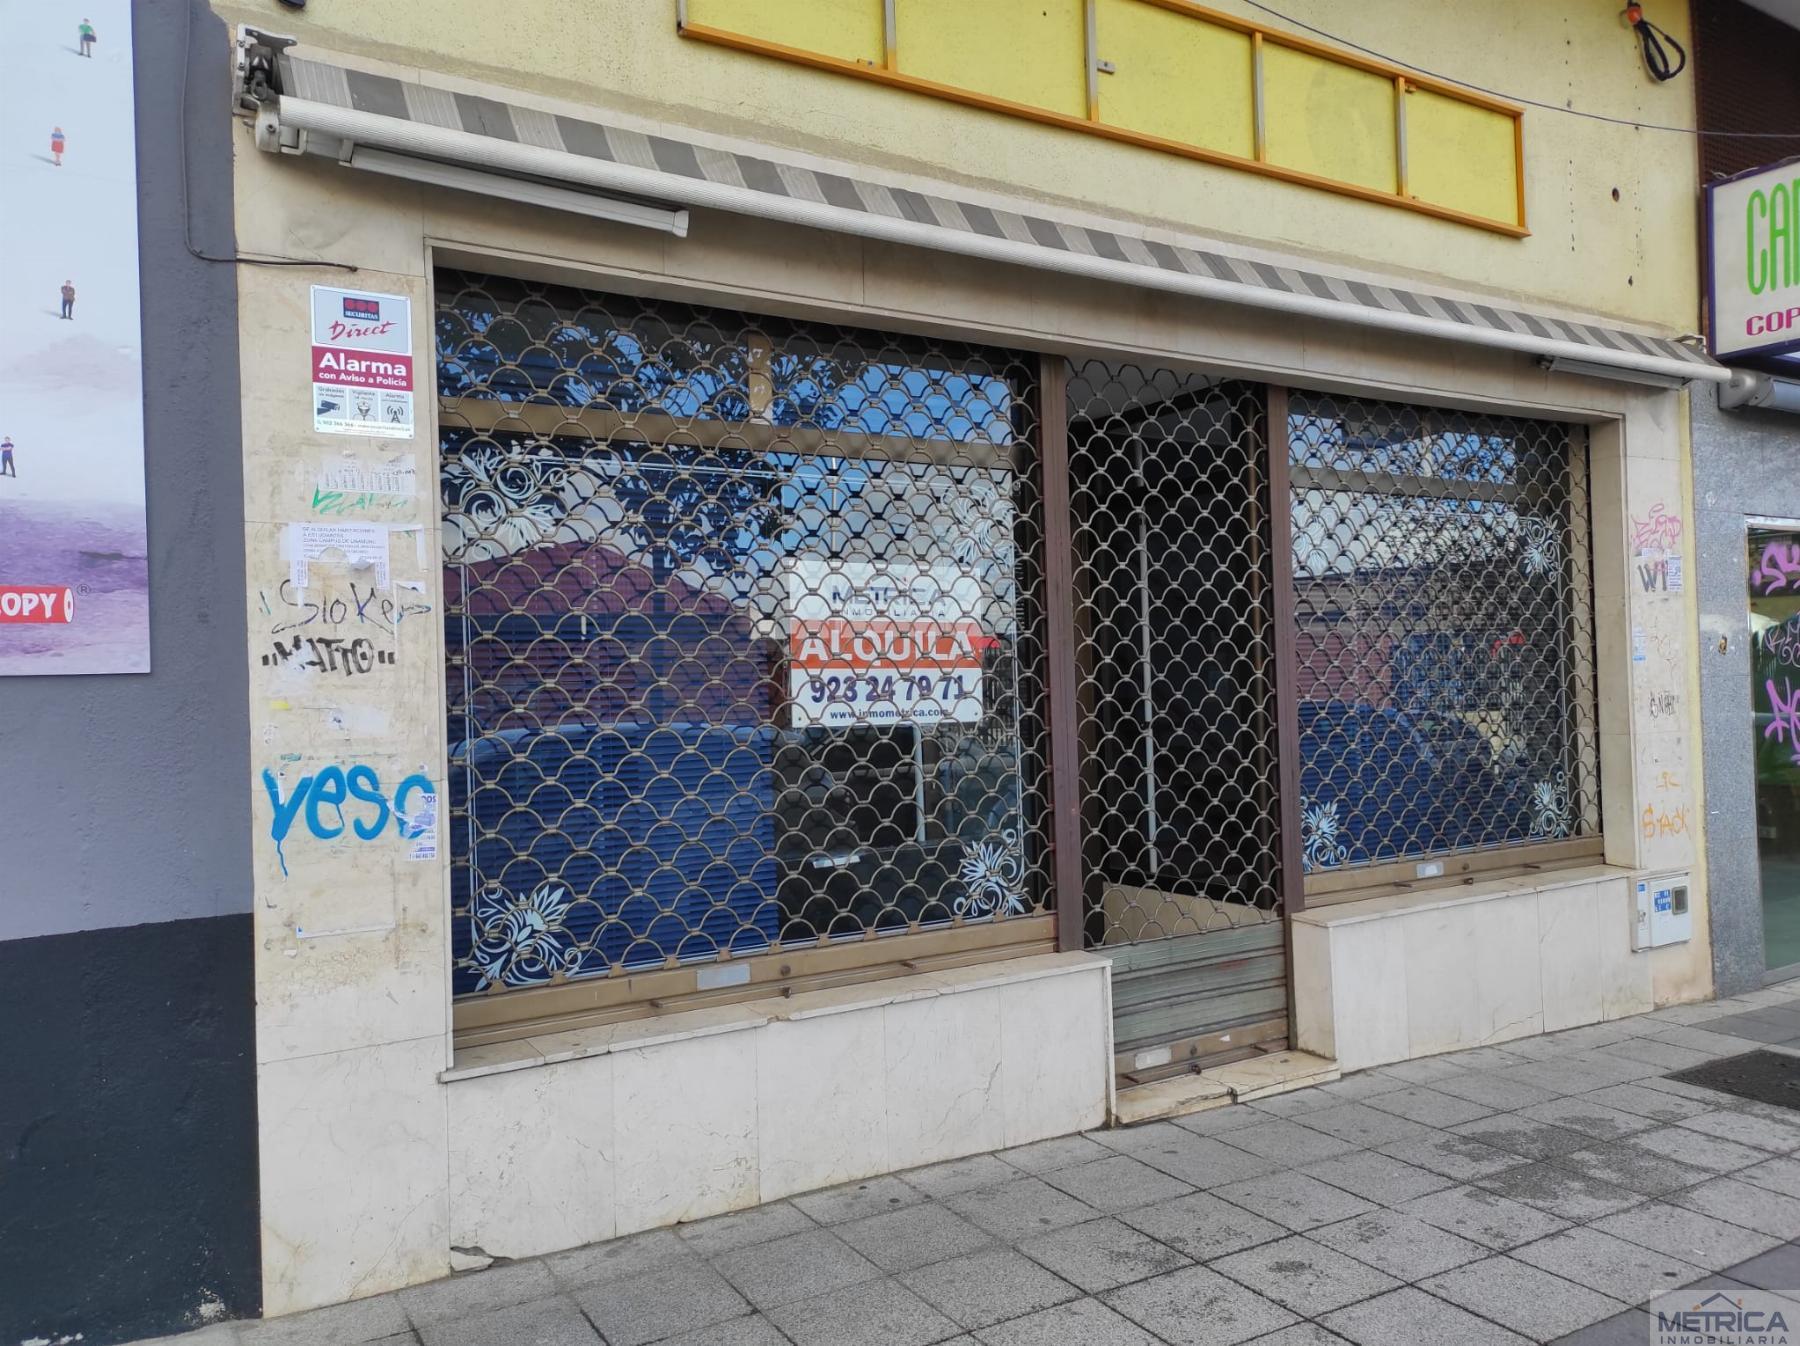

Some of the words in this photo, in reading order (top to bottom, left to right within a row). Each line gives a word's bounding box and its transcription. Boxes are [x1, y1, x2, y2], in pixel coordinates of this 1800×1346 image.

[329, 321, 397, 340] Direct
[319, 352, 407, 376] Alarma
[319, 372, 336, 380] con
[339, 373, 366, 383] Aviso
[376, 376, 407, 387] Policía
[0, 592, 57, 619] OPY
[800, 630, 976, 667] ALQUILA
[810, 676, 858, 703] 923
[865, 675, 896, 701] 24
[906, 675, 932, 701] 79
[938, 675, 964, 700] 71
